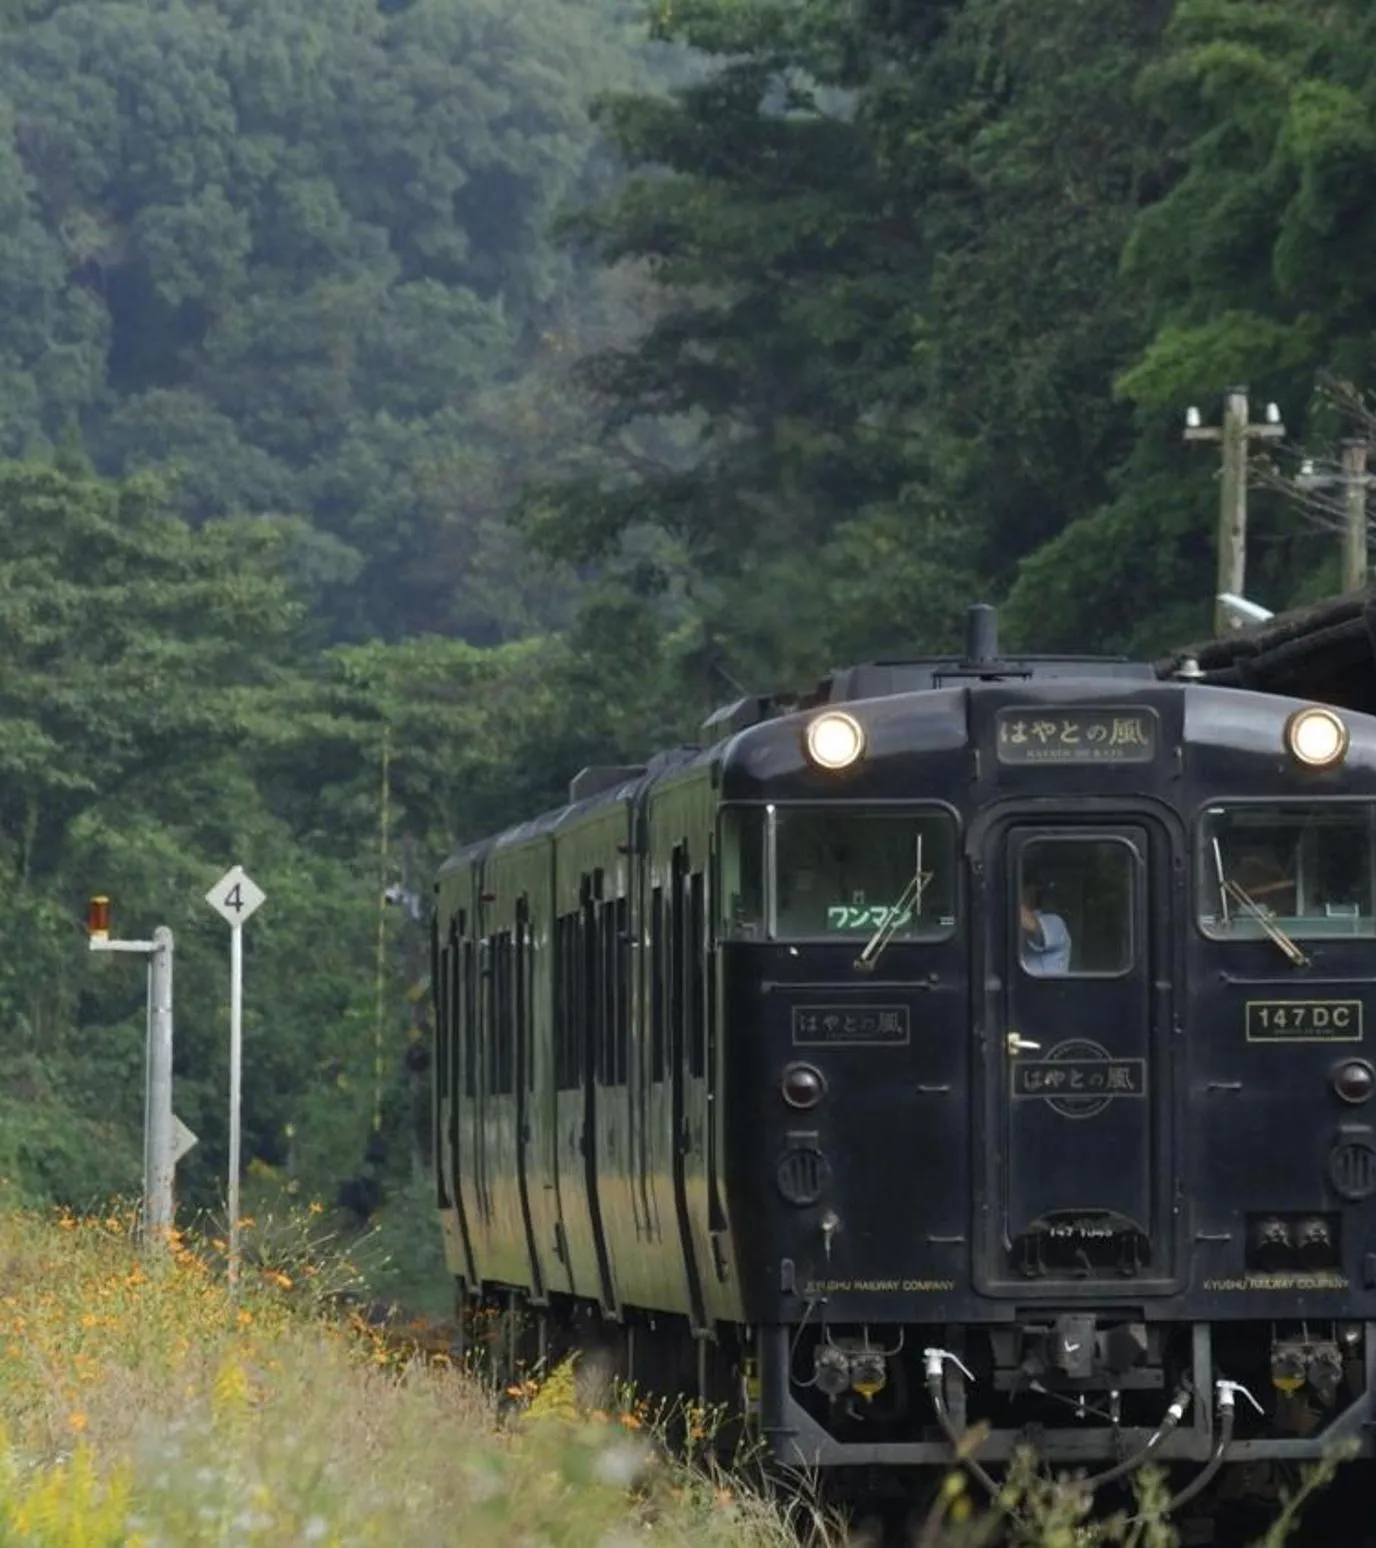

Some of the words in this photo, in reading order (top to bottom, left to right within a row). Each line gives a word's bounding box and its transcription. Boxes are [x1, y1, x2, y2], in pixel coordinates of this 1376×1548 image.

[1000, 718, 1149, 746] はやとの風
[224, 883, 245, 914] 4
[828, 906, 912, 928] ワンマン
[1024, 1067, 1135, 1091] はやとの風
[902, 1280, 955, 1291] COMPANY
[1203, 1279, 1247, 1291] KYUSHU
